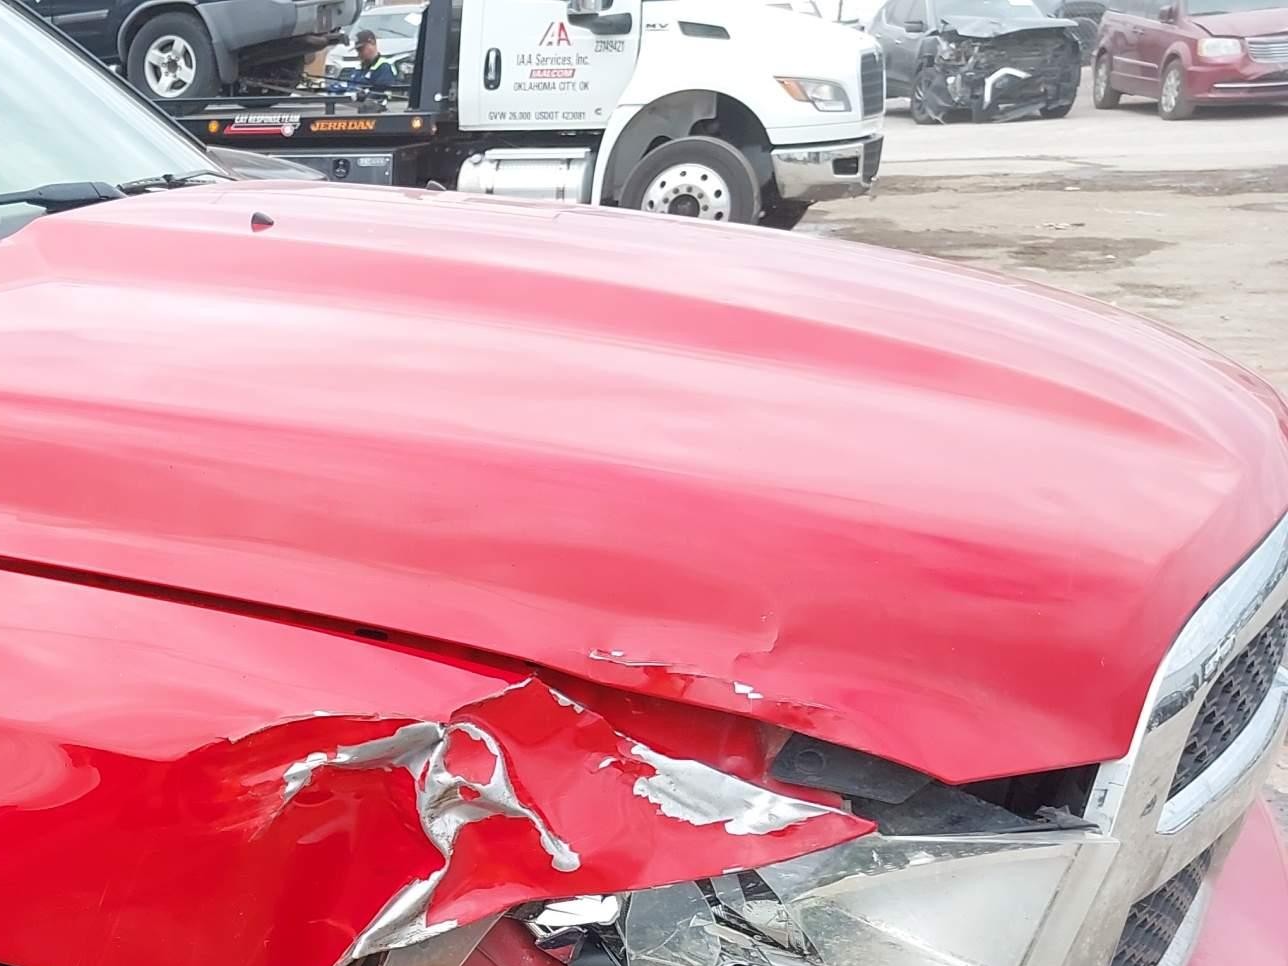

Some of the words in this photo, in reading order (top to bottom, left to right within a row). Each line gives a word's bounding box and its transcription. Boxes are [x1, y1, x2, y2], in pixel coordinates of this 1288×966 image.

[517, 54, 532, 65] IAA
[513, 82, 555, 91] OKLAHOMA
[579, 82, 589, 90] OK
[235, 115, 247, 123] CAT
[248, 115, 279, 123] RESPONSE
[280, 114, 300, 122] TEAM
[488, 112, 506, 120] GVW
[535, 112, 559, 120] USDOT
